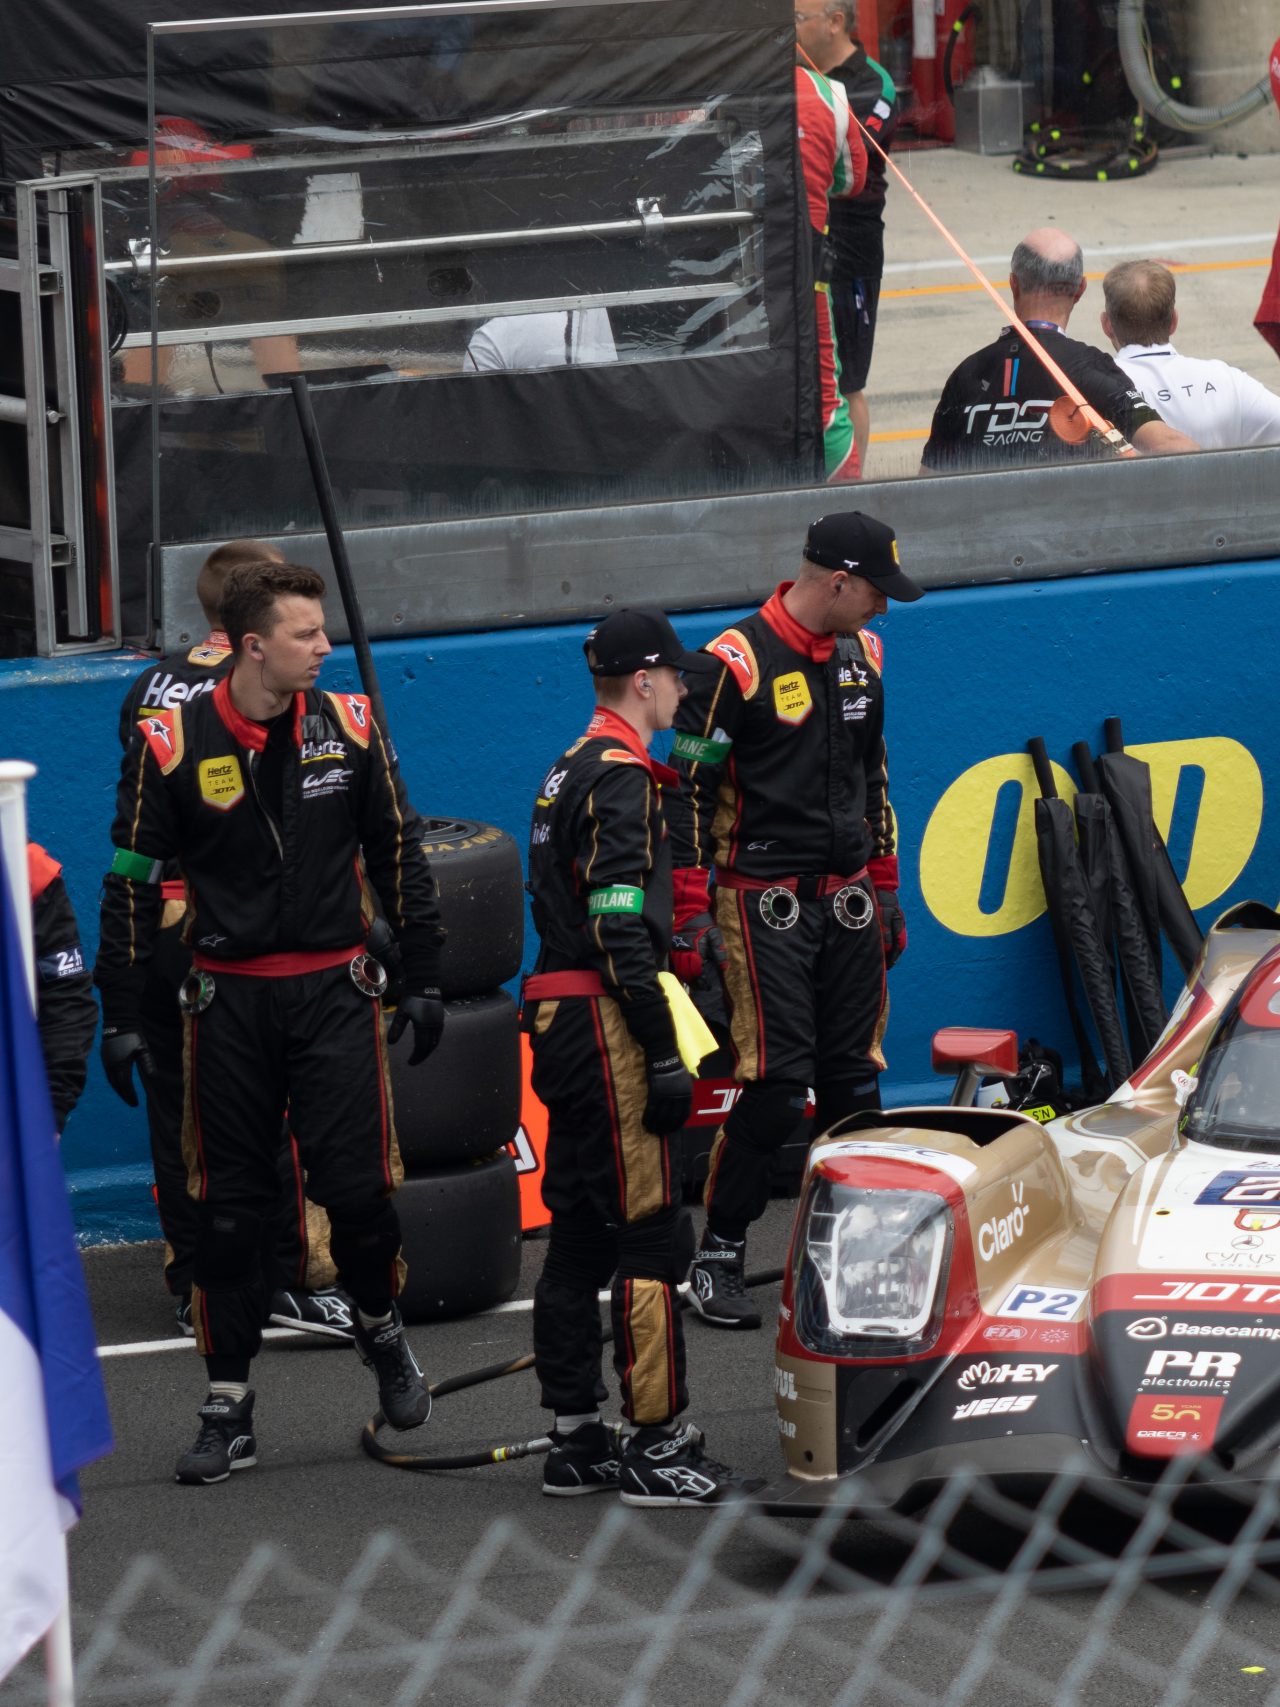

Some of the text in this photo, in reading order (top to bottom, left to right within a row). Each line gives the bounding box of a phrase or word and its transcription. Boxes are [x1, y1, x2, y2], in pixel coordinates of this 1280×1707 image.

[1141, 381, 1217, 402] ISTA
[963, 399, 1055, 435] TDS
[982, 430, 1044, 446] RACING
[142, 672, 217, 709] Hert
[779, 681, 800, 694] Hertz
[780, 692, 803, 702] TEAM
[784, 700, 805, 711] JOTA
[207, 764, 233, 778] Hertz
[208, 778, 234, 787] TEAM
[210, 786, 236, 796] JOTA
[978, 1203, 1027, 1263] Claro
[1007, 1289, 1079, 1316] P2
[985, 1326, 1023, 1340] FIA
[1144, 1350, 1242, 1377] PR
[997, 1364, 1060, 1383] HEY
[1141, 1376, 1232, 1388] electronics
[952, 1395, 1038, 1420] JEGS
